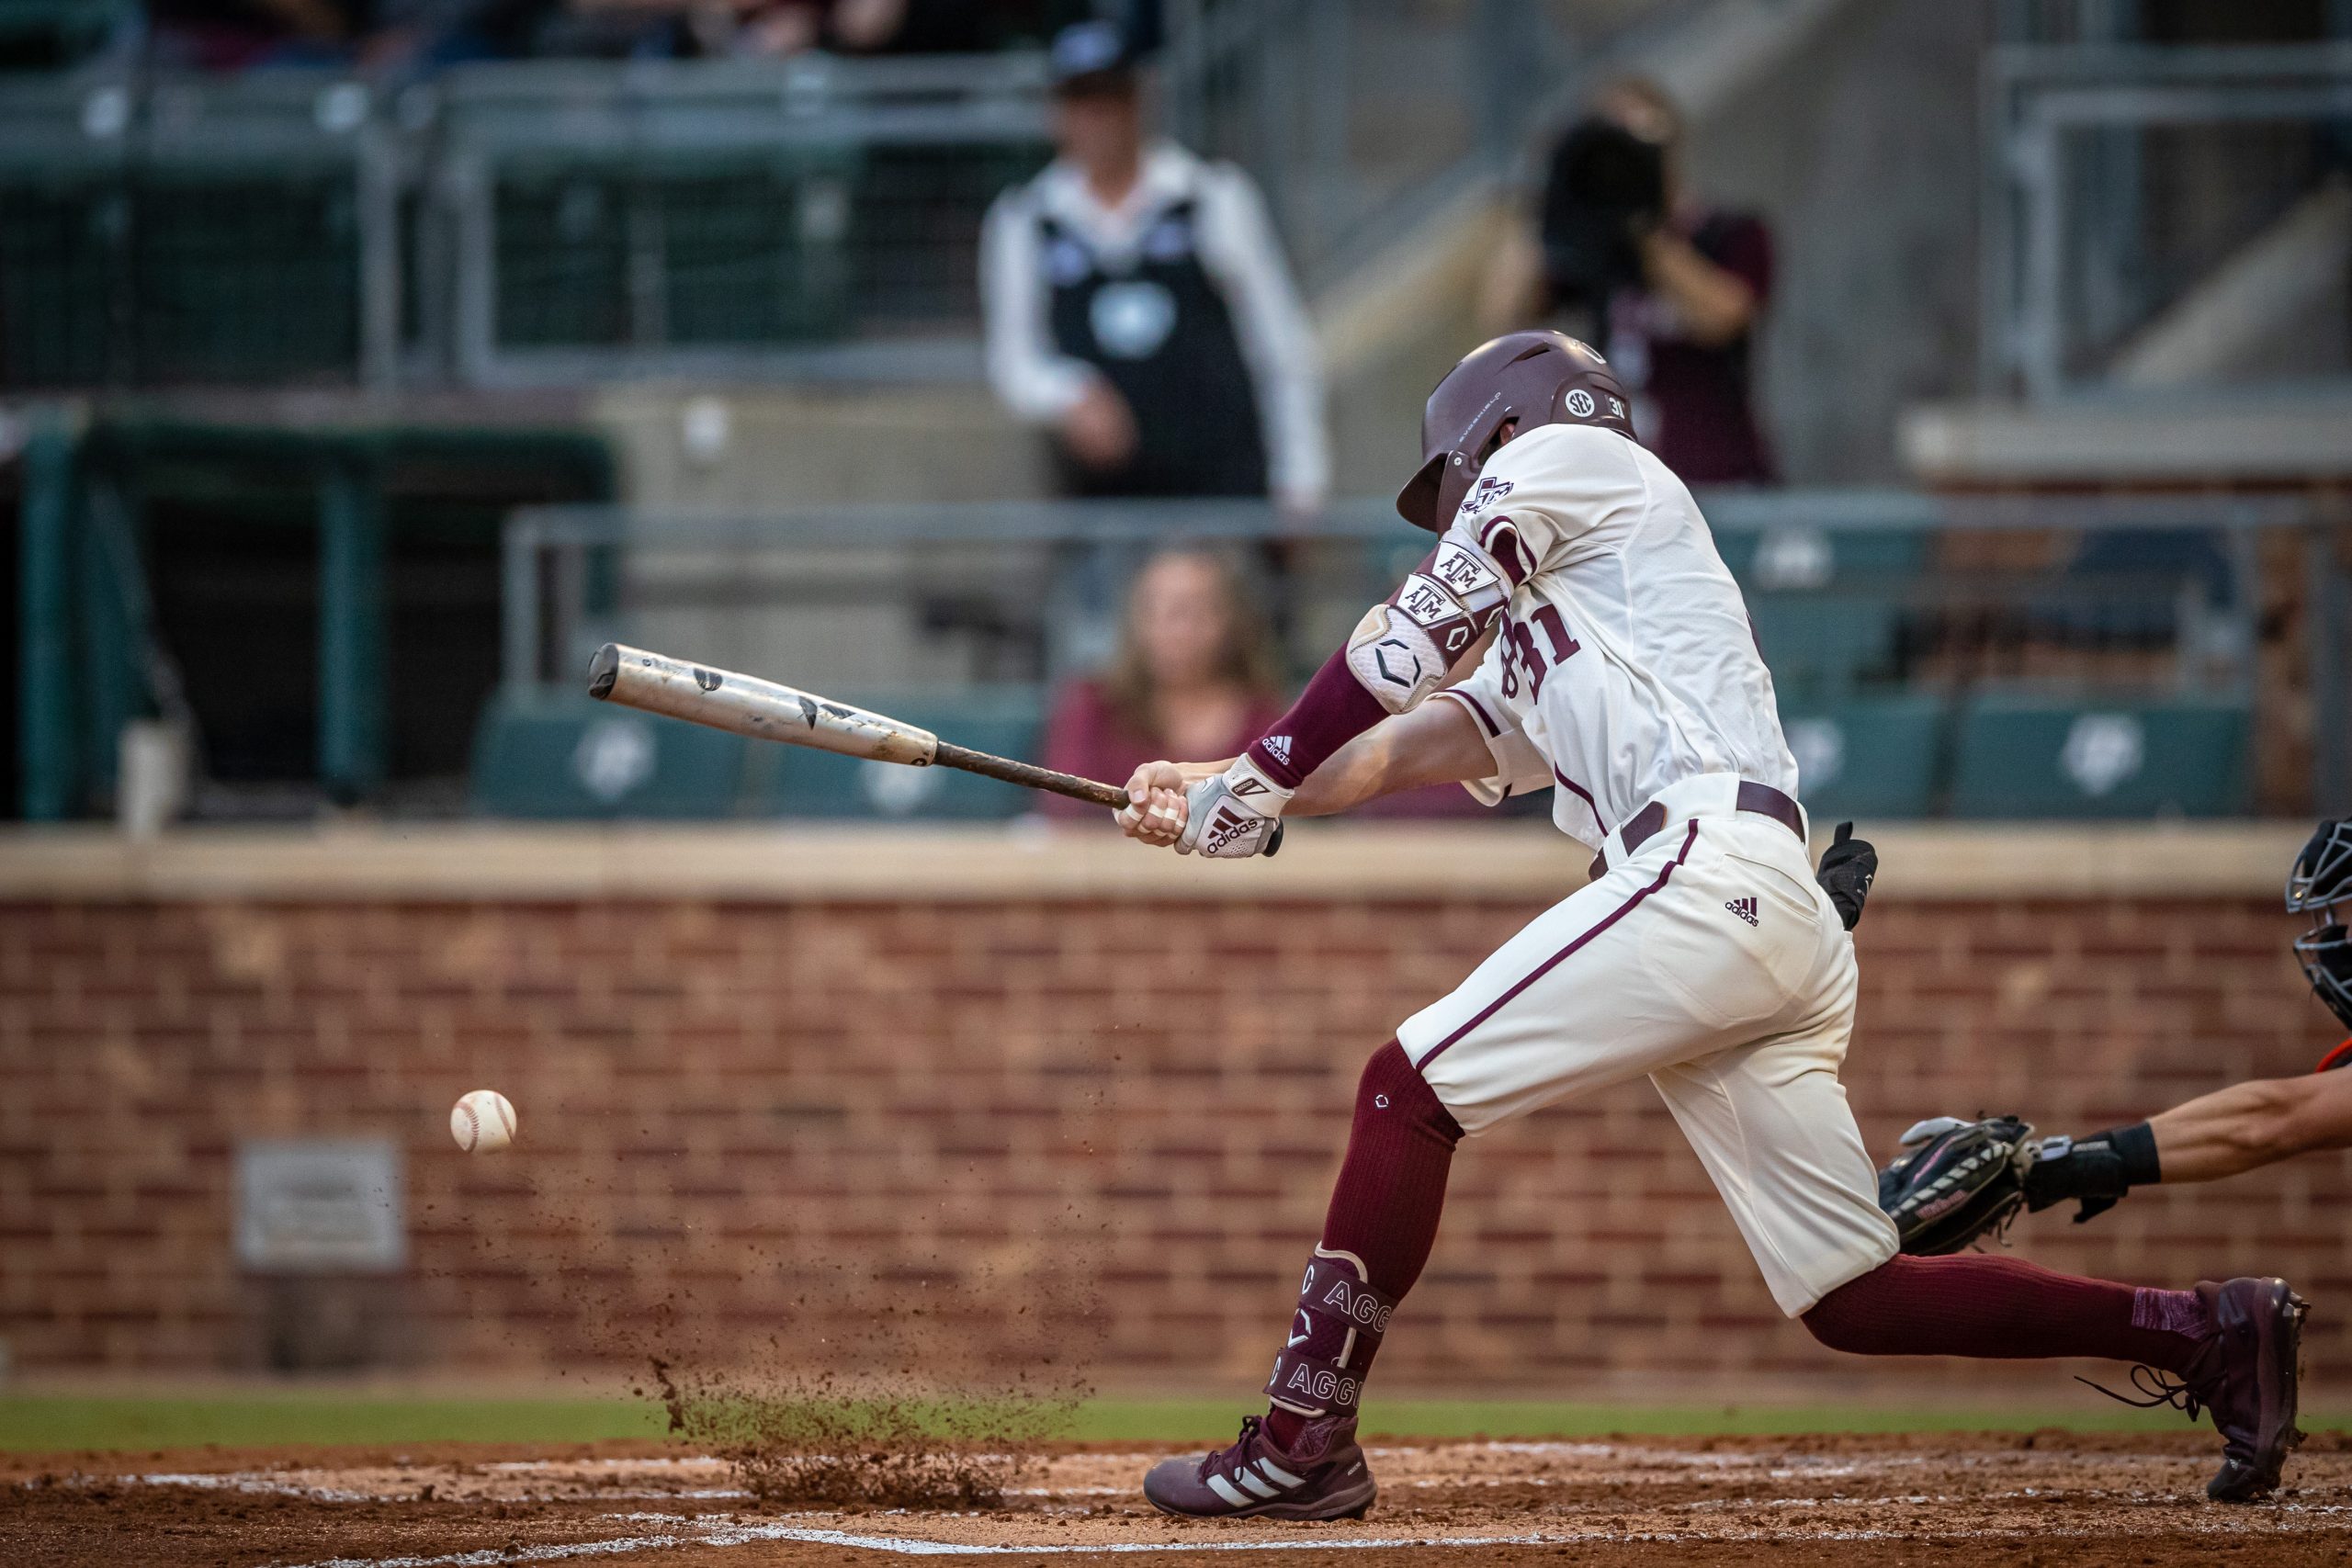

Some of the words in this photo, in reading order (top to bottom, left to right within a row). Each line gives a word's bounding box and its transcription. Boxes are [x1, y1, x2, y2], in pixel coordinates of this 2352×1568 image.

[1567, 392, 1592, 414] SEC
[1609, 397, 1625, 419] 31
[1261, 738, 1290, 765] adidas
[1207, 818, 1258, 854] adidas
[1724, 901, 1759, 927] adidas
